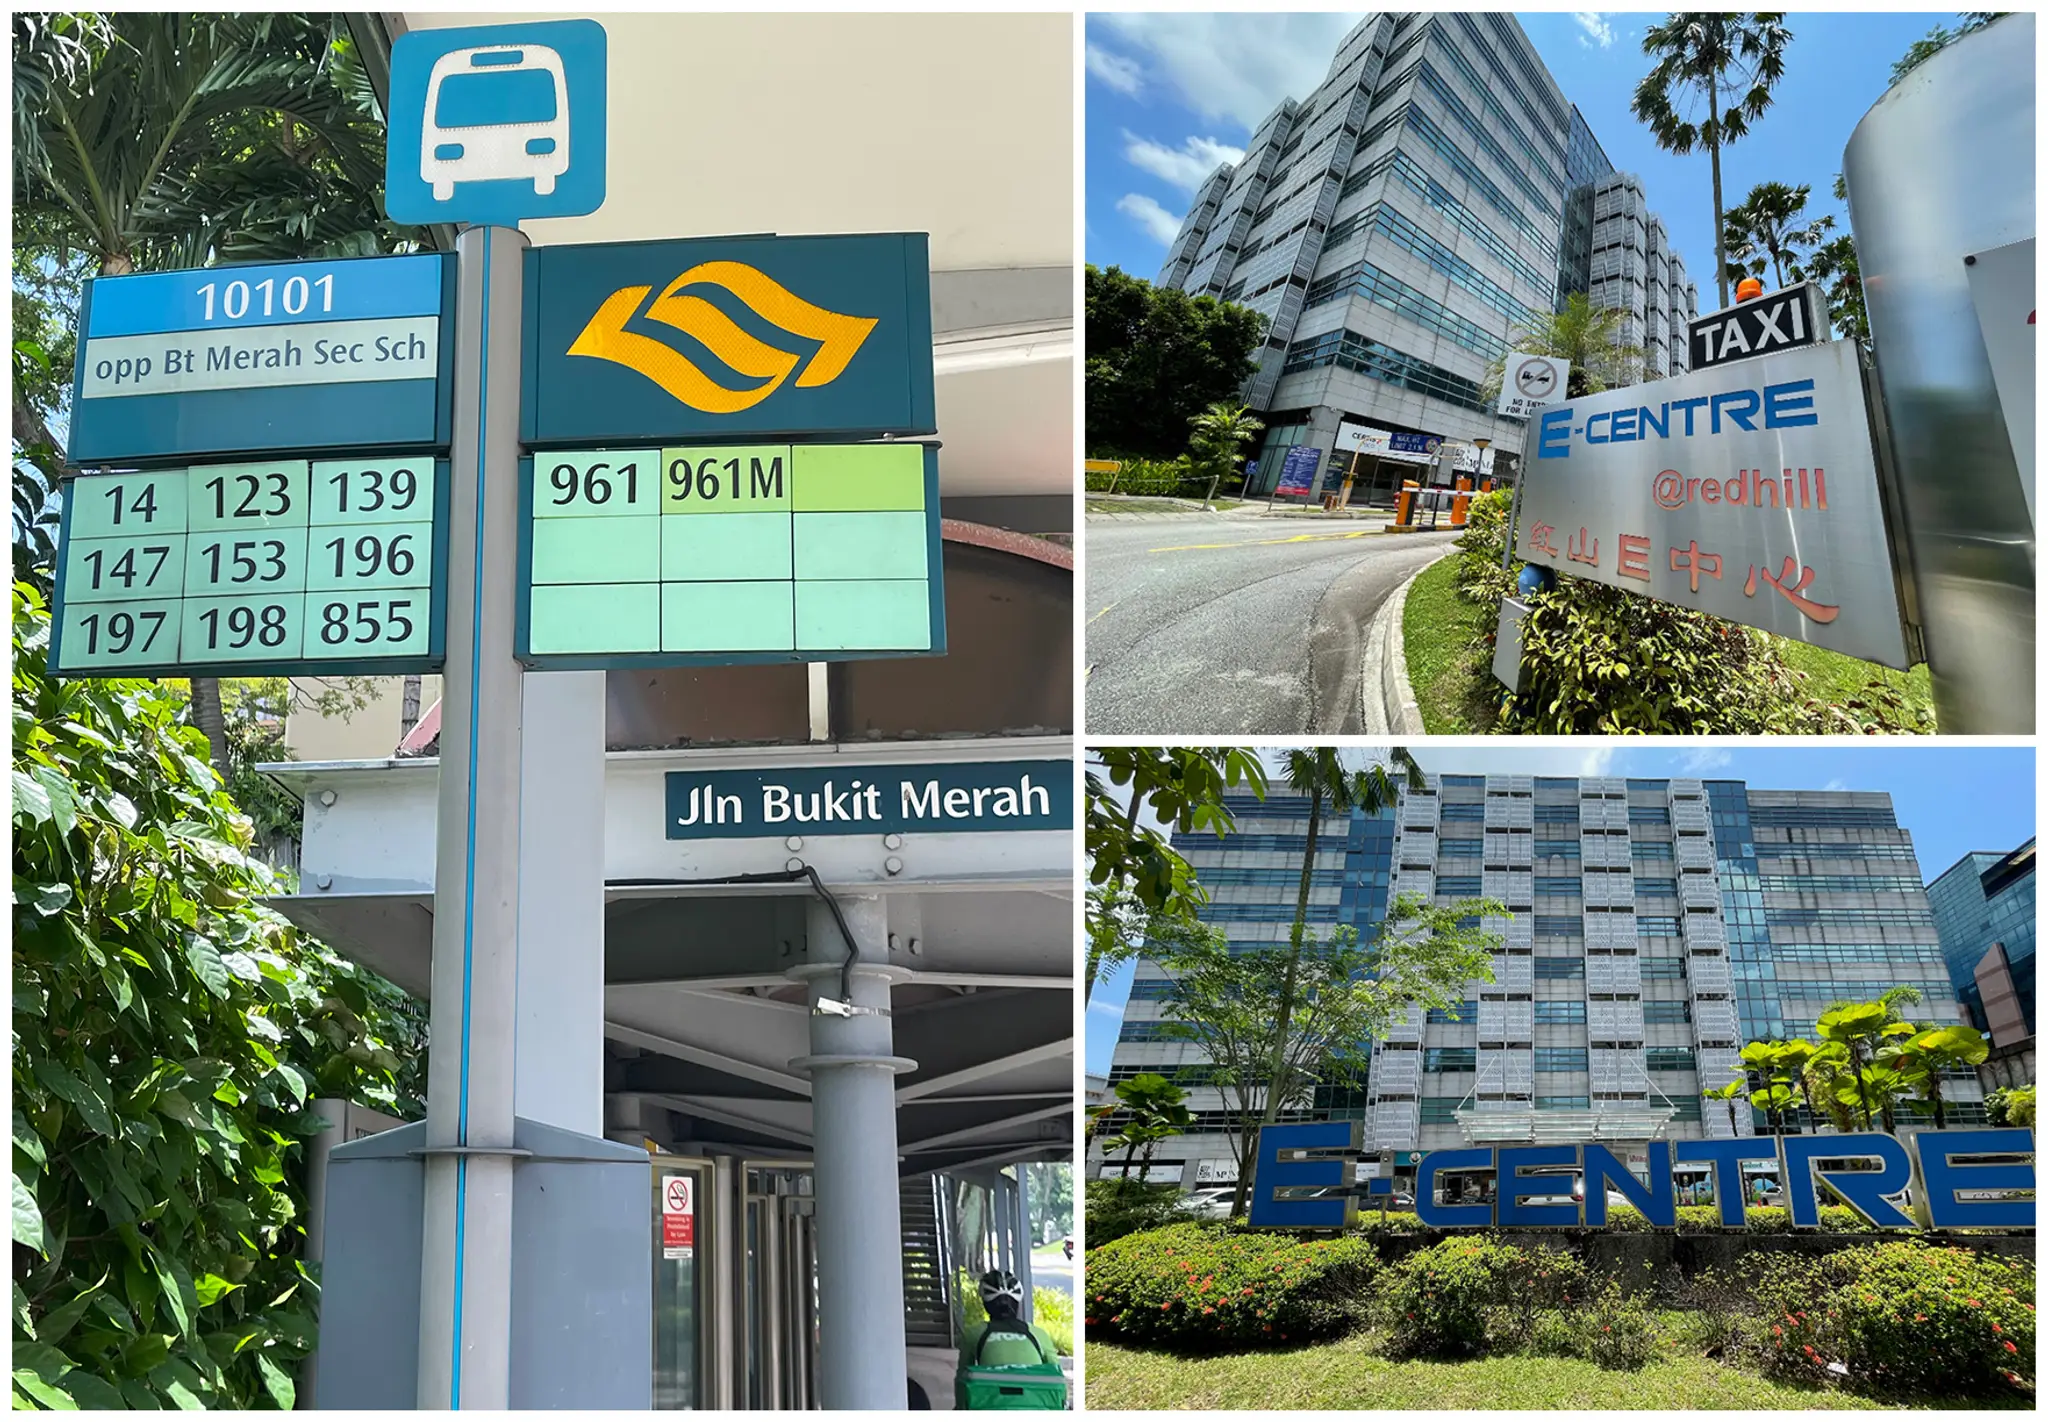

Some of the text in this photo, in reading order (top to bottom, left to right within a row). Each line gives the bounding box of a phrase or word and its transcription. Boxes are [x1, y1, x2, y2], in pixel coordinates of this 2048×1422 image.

[197, 274, 334, 320] 10101
[1696, 298, 1807, 362] TAXI
[95, 333, 426, 384] opp Bt Merah Sec Sch
[1538, 378, 1819, 459] E-CENTRE
[104, 469, 417, 525] 14 123 139
[550, 457, 784, 505] 961 961M
[1652, 468, 1828, 511] @redhill
[83, 534, 415, 591] 147 153 196
[79, 600, 413, 655] 197 198 855
[677, 775, 1050, 826] Jln Bukit Merah
[1249, 1121, 2036, 1232] E-CENTRE
